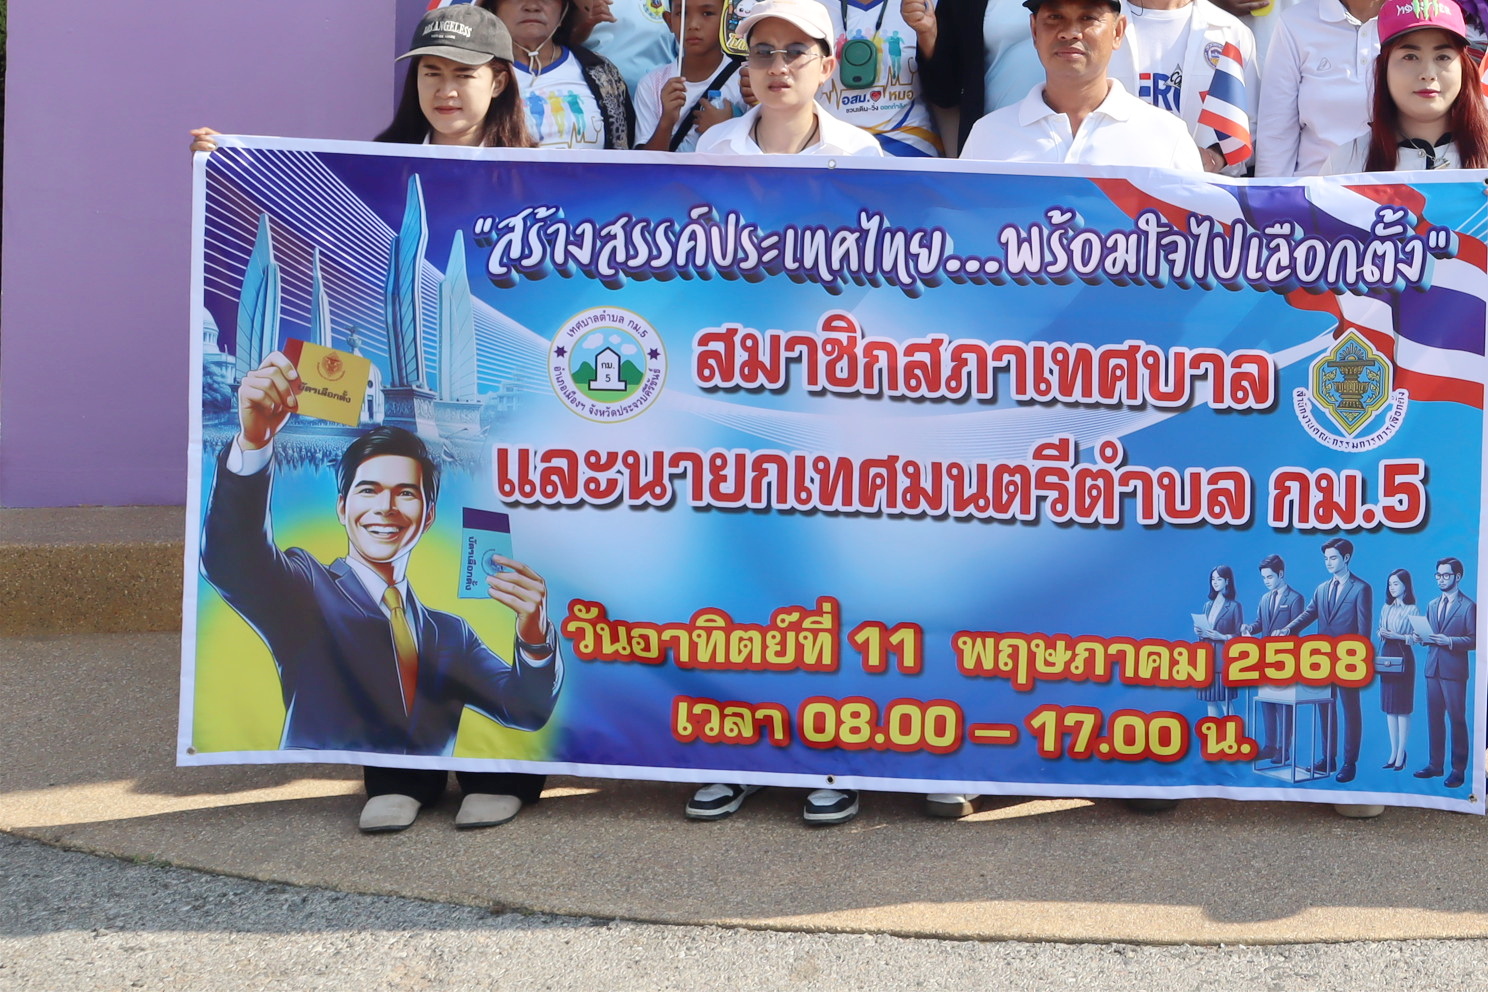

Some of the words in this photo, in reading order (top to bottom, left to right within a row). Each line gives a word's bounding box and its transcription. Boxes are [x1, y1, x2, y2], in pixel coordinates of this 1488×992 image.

[841, 93, 870, 105] อสม.
[888, 89, 914, 101] หมอ
[566, 309, 625, 338] เทศบาลตำบล
[627, 318, 649, 338] กม.5
[605, 374, 611, 383] 5
[695, 312, 1272, 407] สมาชิกสภาเทศบาล
[496, 436, 1247, 521] และนายกเทศมนตรีตำบล
[1271, 463, 1421, 527] กม.5
[566, 602, 833, 666] วันอาทิตย์ที่
[853, 627, 916, 668] 11
[956, 634, 1207, 686] พฤษภาคม
[1228, 640, 1368, 682] 2568
[676, 700, 784, 740] เวลา
[803, 703, 957, 747] 08.00
[1030, 711, 1183, 756] 17.00
[1200, 720, 1252, 756] น.
